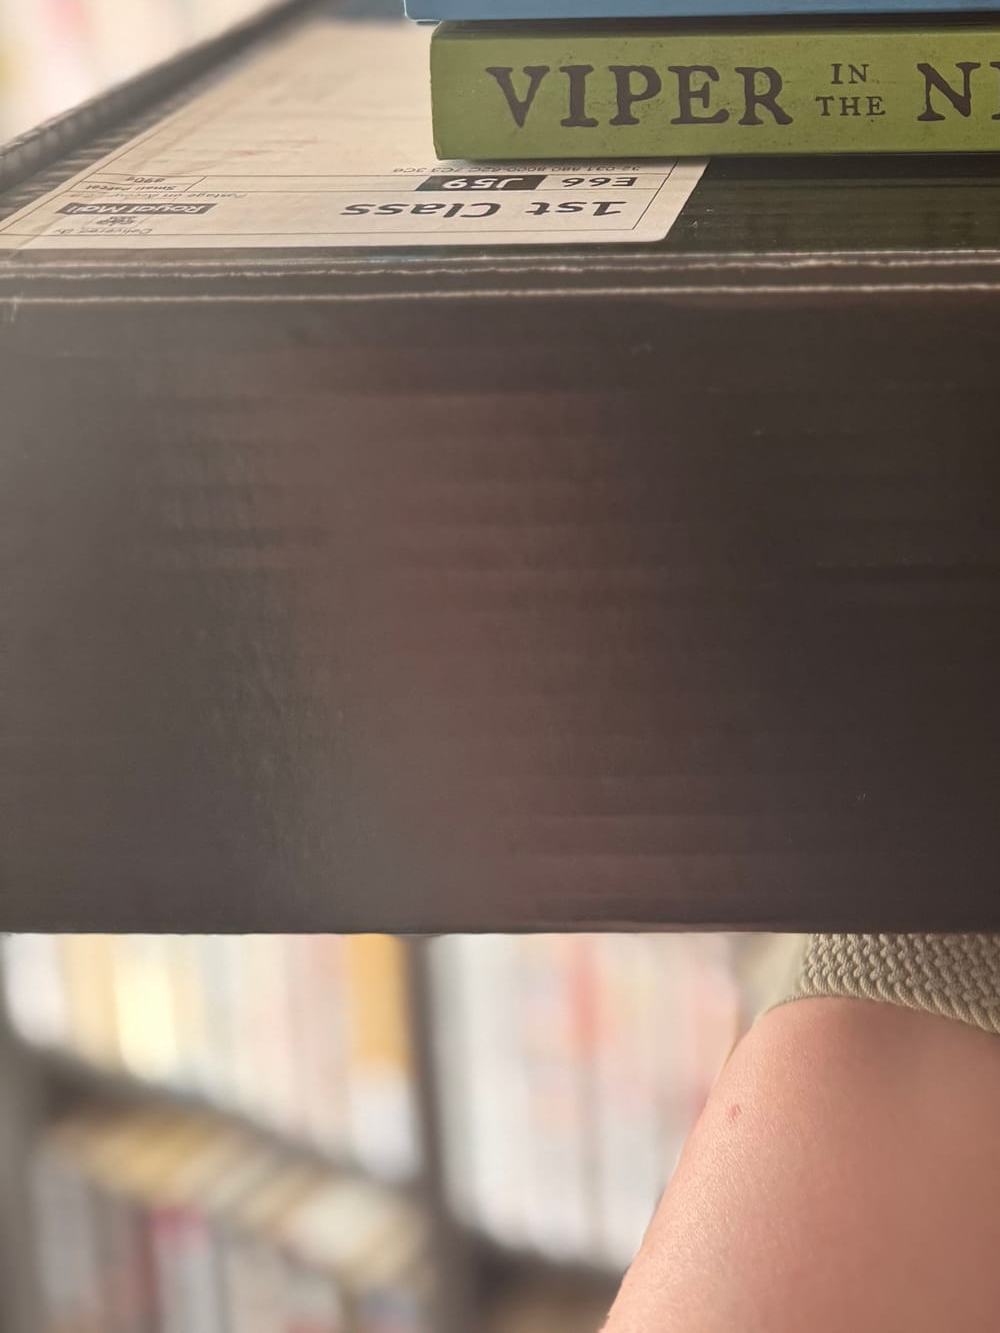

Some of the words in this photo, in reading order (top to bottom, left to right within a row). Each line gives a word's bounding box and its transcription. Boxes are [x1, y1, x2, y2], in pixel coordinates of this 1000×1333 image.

[830, 64, 870, 84] IN
[486, 65, 793, 128] VIPER
[815, 96, 887, 116] THE
[441, 177, 525, 189] J59
[561, 177, 638, 187] E66
[65, 204, 126, 214] Mail
[130, 204, 205, 214] Royal
[341, 202, 501, 218] Class
[525, 201, 627, 217] 1st
